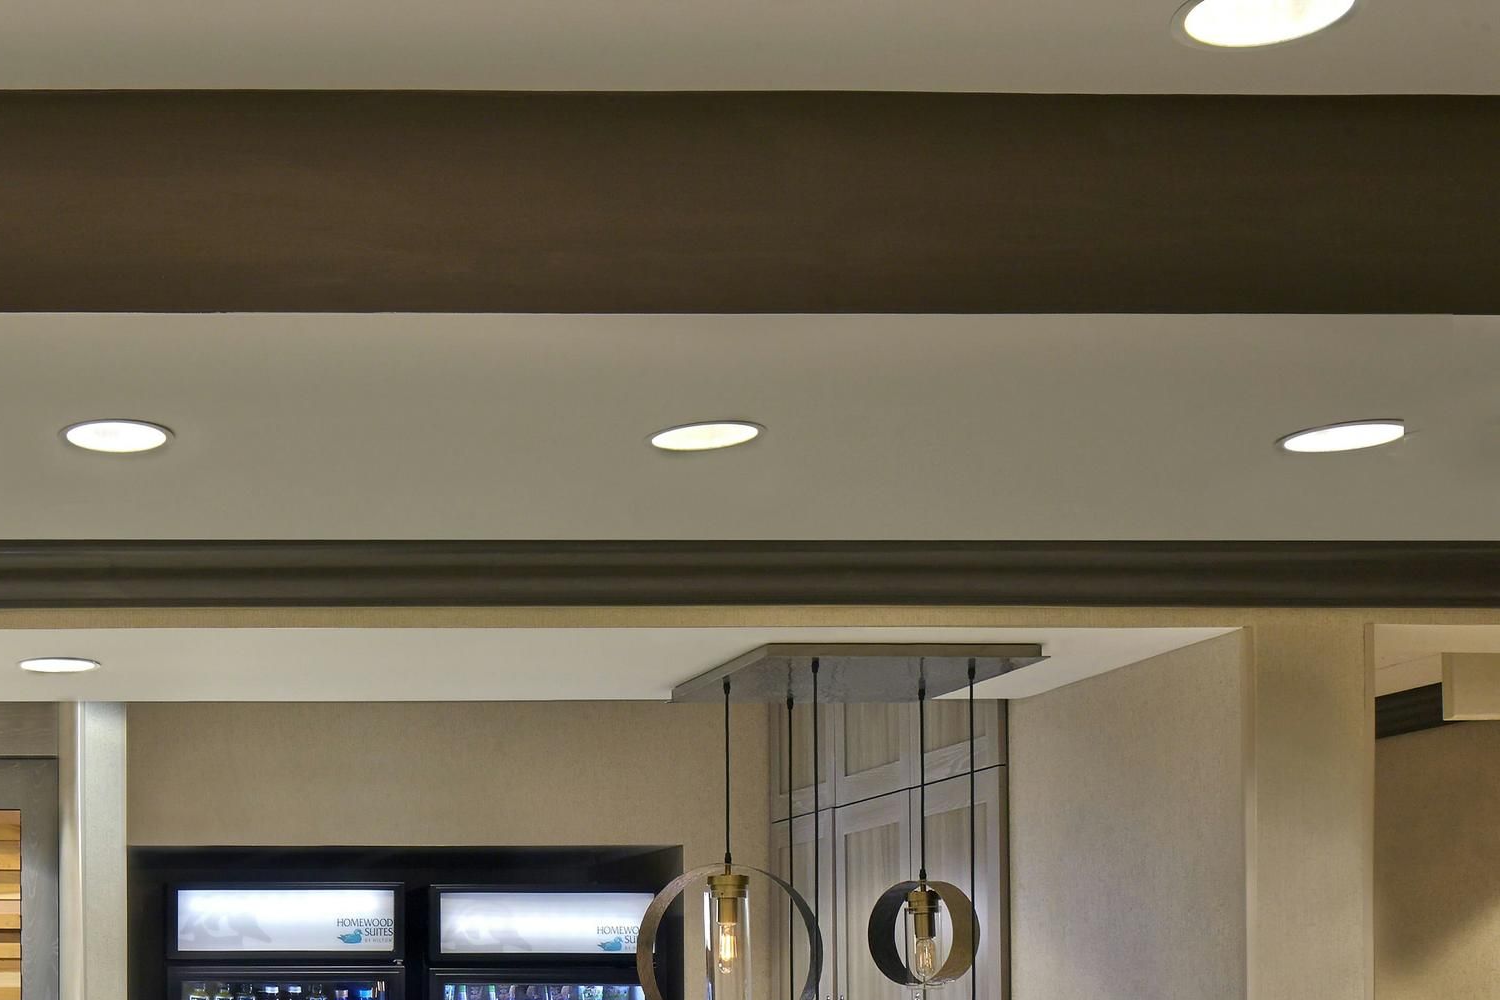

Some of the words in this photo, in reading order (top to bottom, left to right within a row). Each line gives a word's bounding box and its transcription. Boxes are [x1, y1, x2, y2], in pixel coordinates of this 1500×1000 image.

[336, 918, 394, 927] HOMEWOOD
[364, 928, 394, 936] SUITES
[596, 926, 640, 934] HOMEWO
